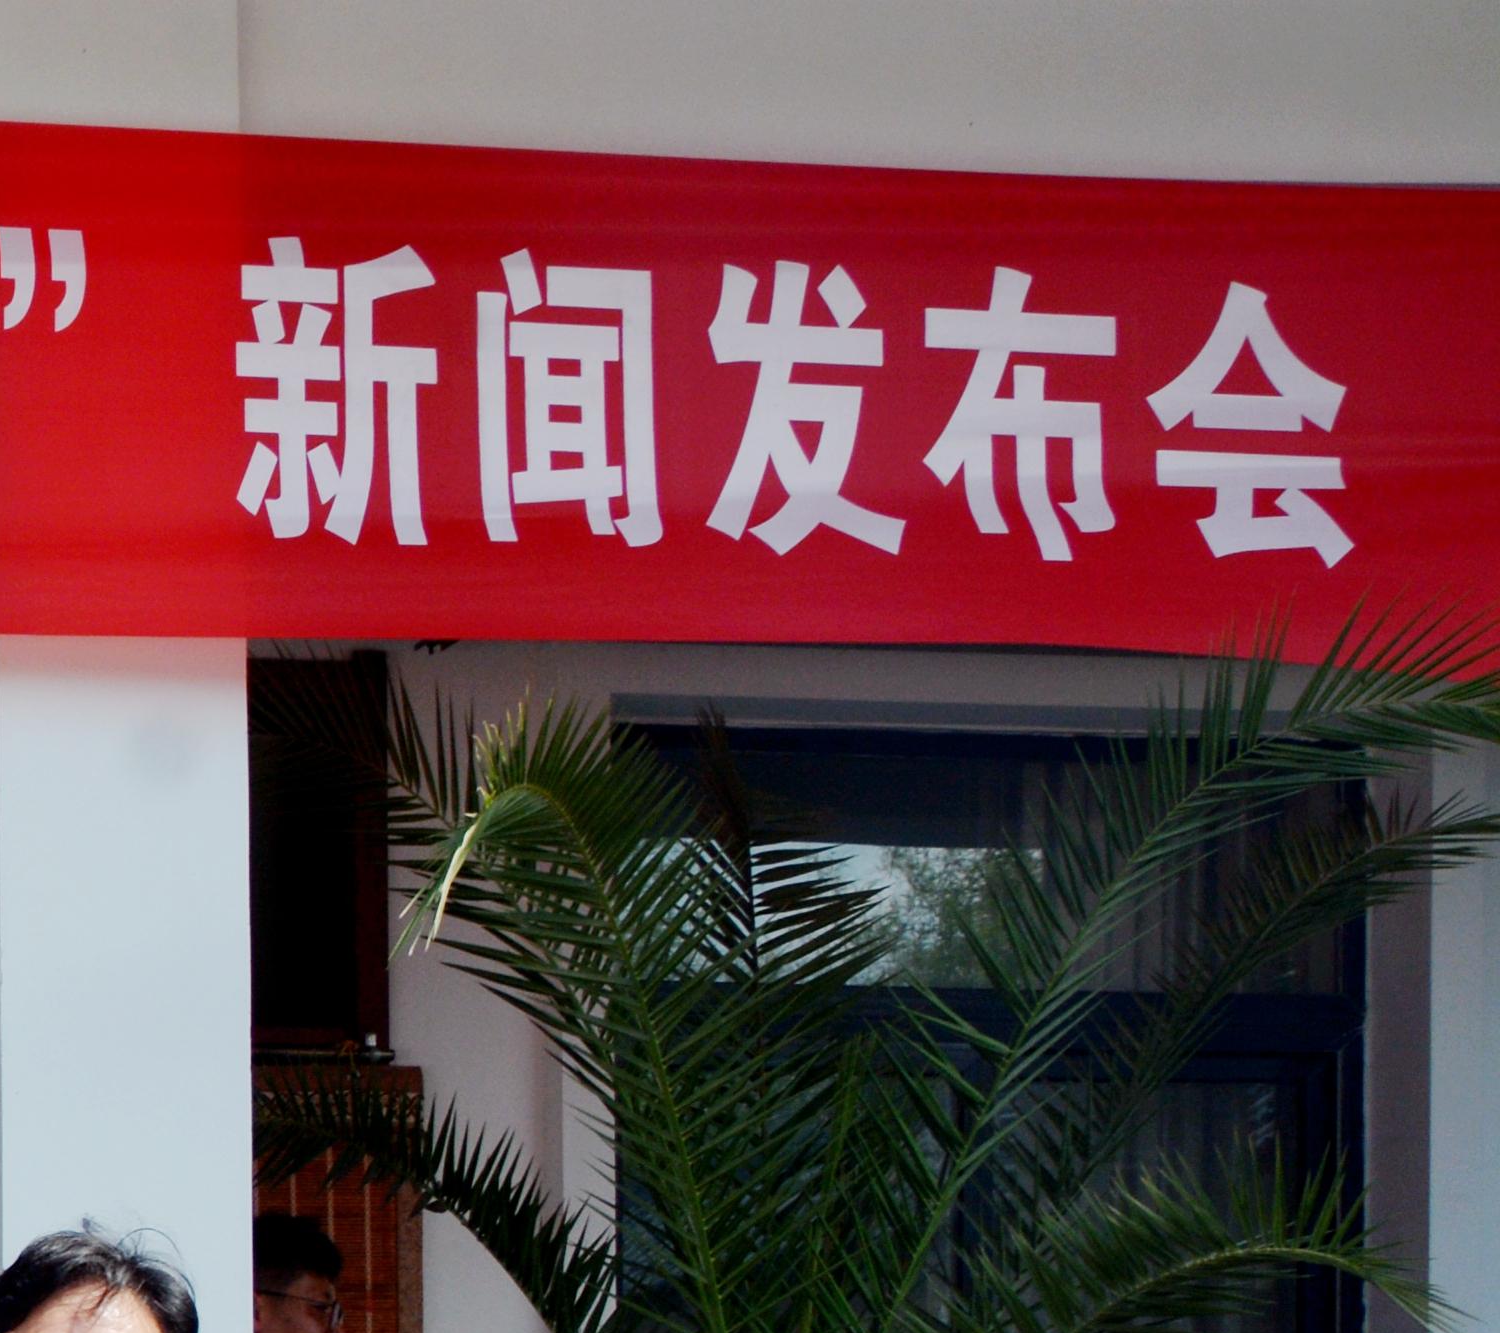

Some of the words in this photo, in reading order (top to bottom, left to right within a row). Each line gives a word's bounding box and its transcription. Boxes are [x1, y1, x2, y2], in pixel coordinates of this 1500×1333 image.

[236, 237, 1354, 568] 新闻发布会
